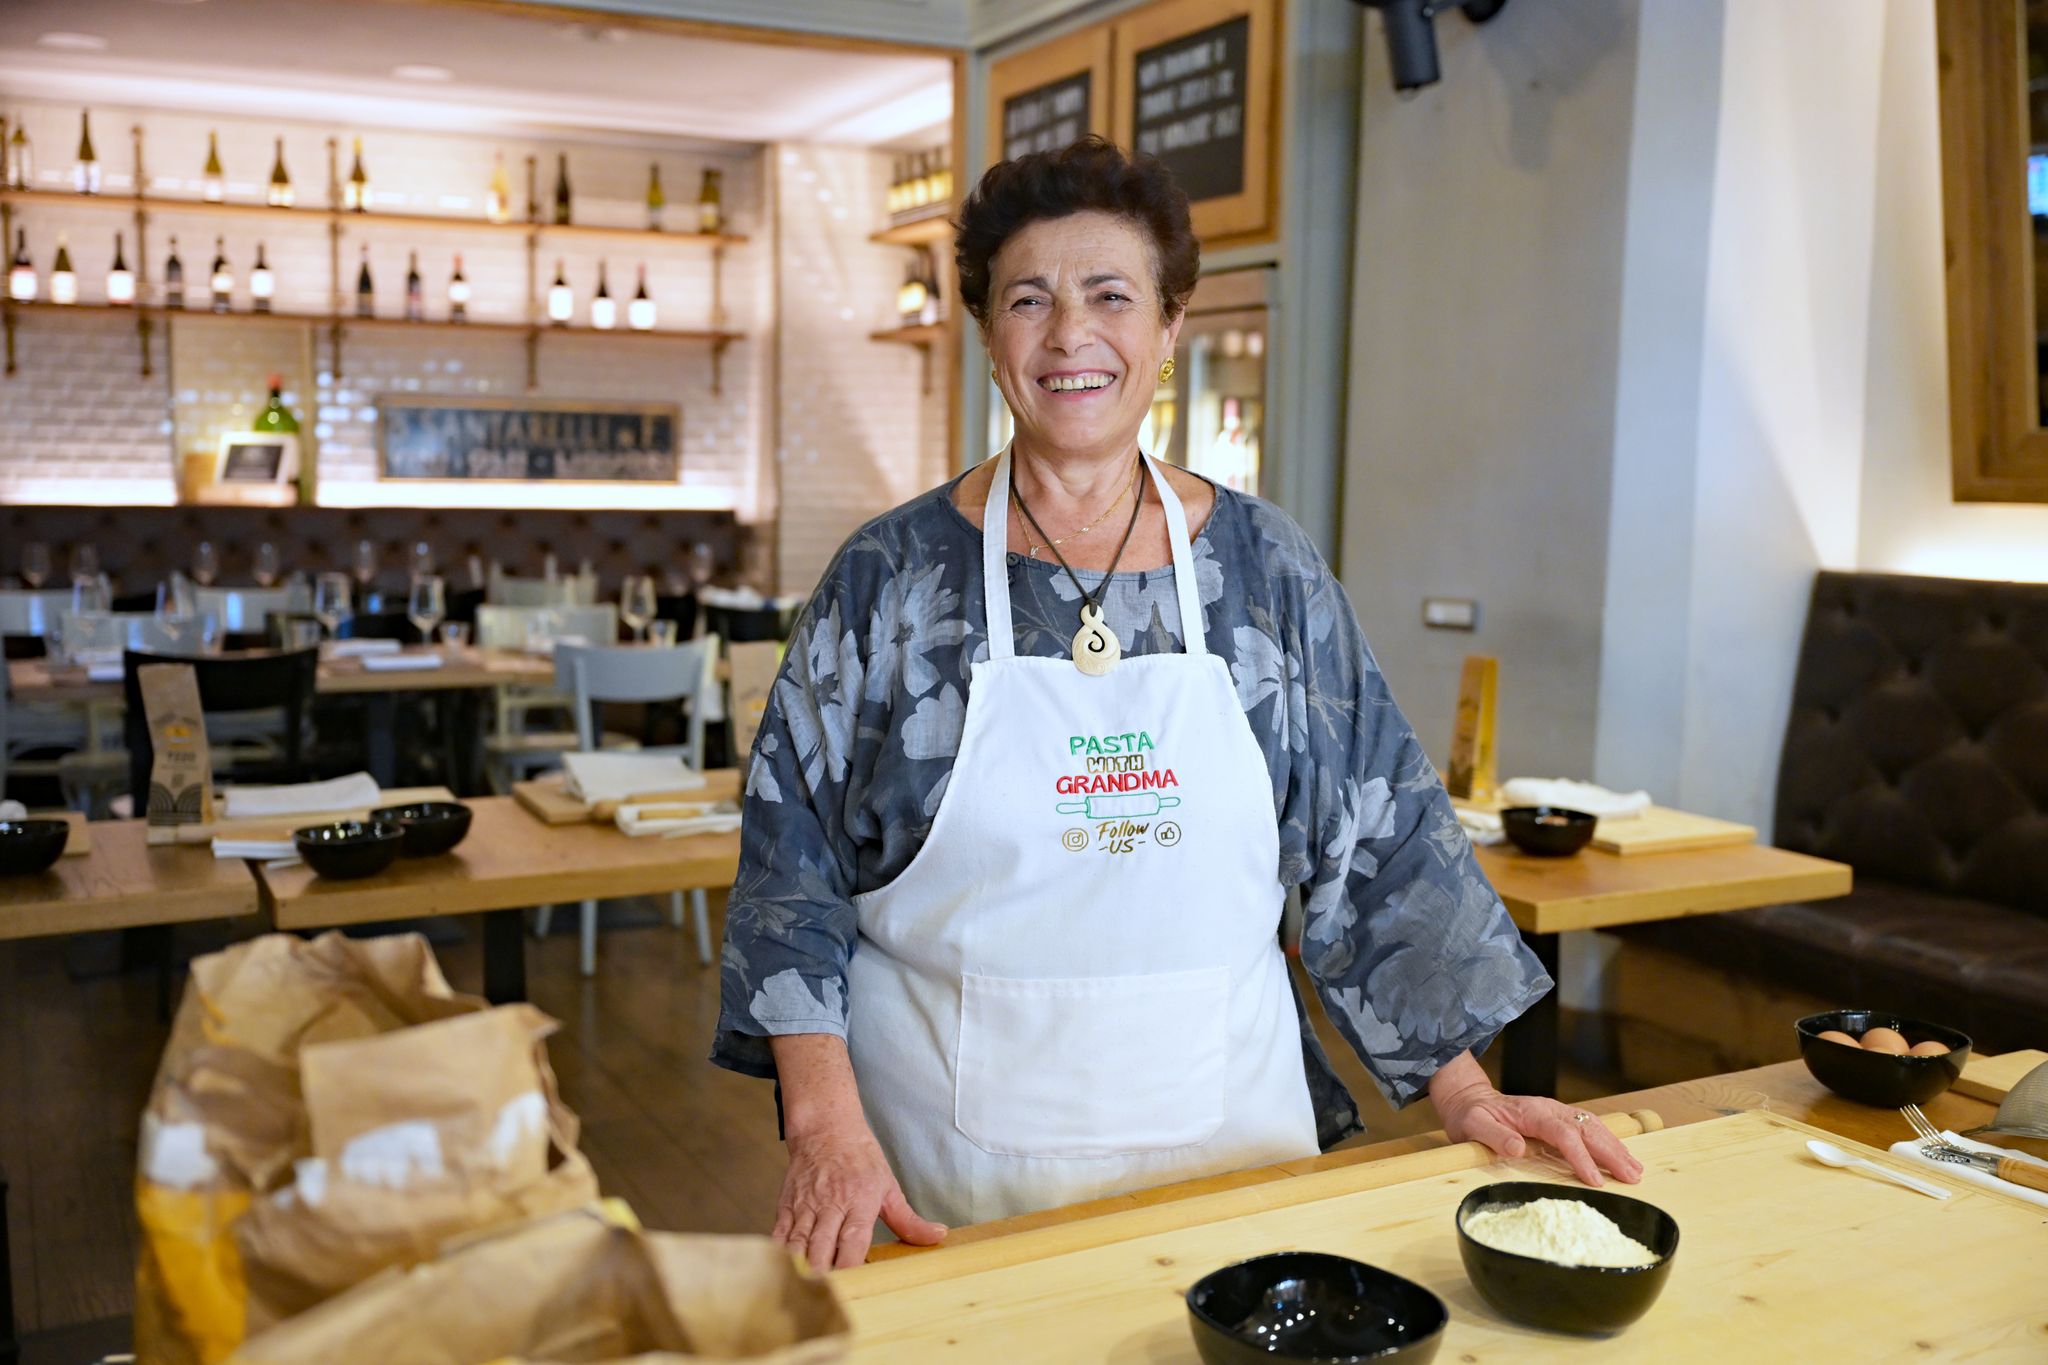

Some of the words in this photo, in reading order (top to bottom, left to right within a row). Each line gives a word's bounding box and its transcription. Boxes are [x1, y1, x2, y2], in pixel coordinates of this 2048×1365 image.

[1069, 731, 1154, 755] PASTA
[1087, 754, 1144, 774] WITH
[1056, 768, 1179, 794] GRANDMA
[1096, 820, 1150, 841] Follow
